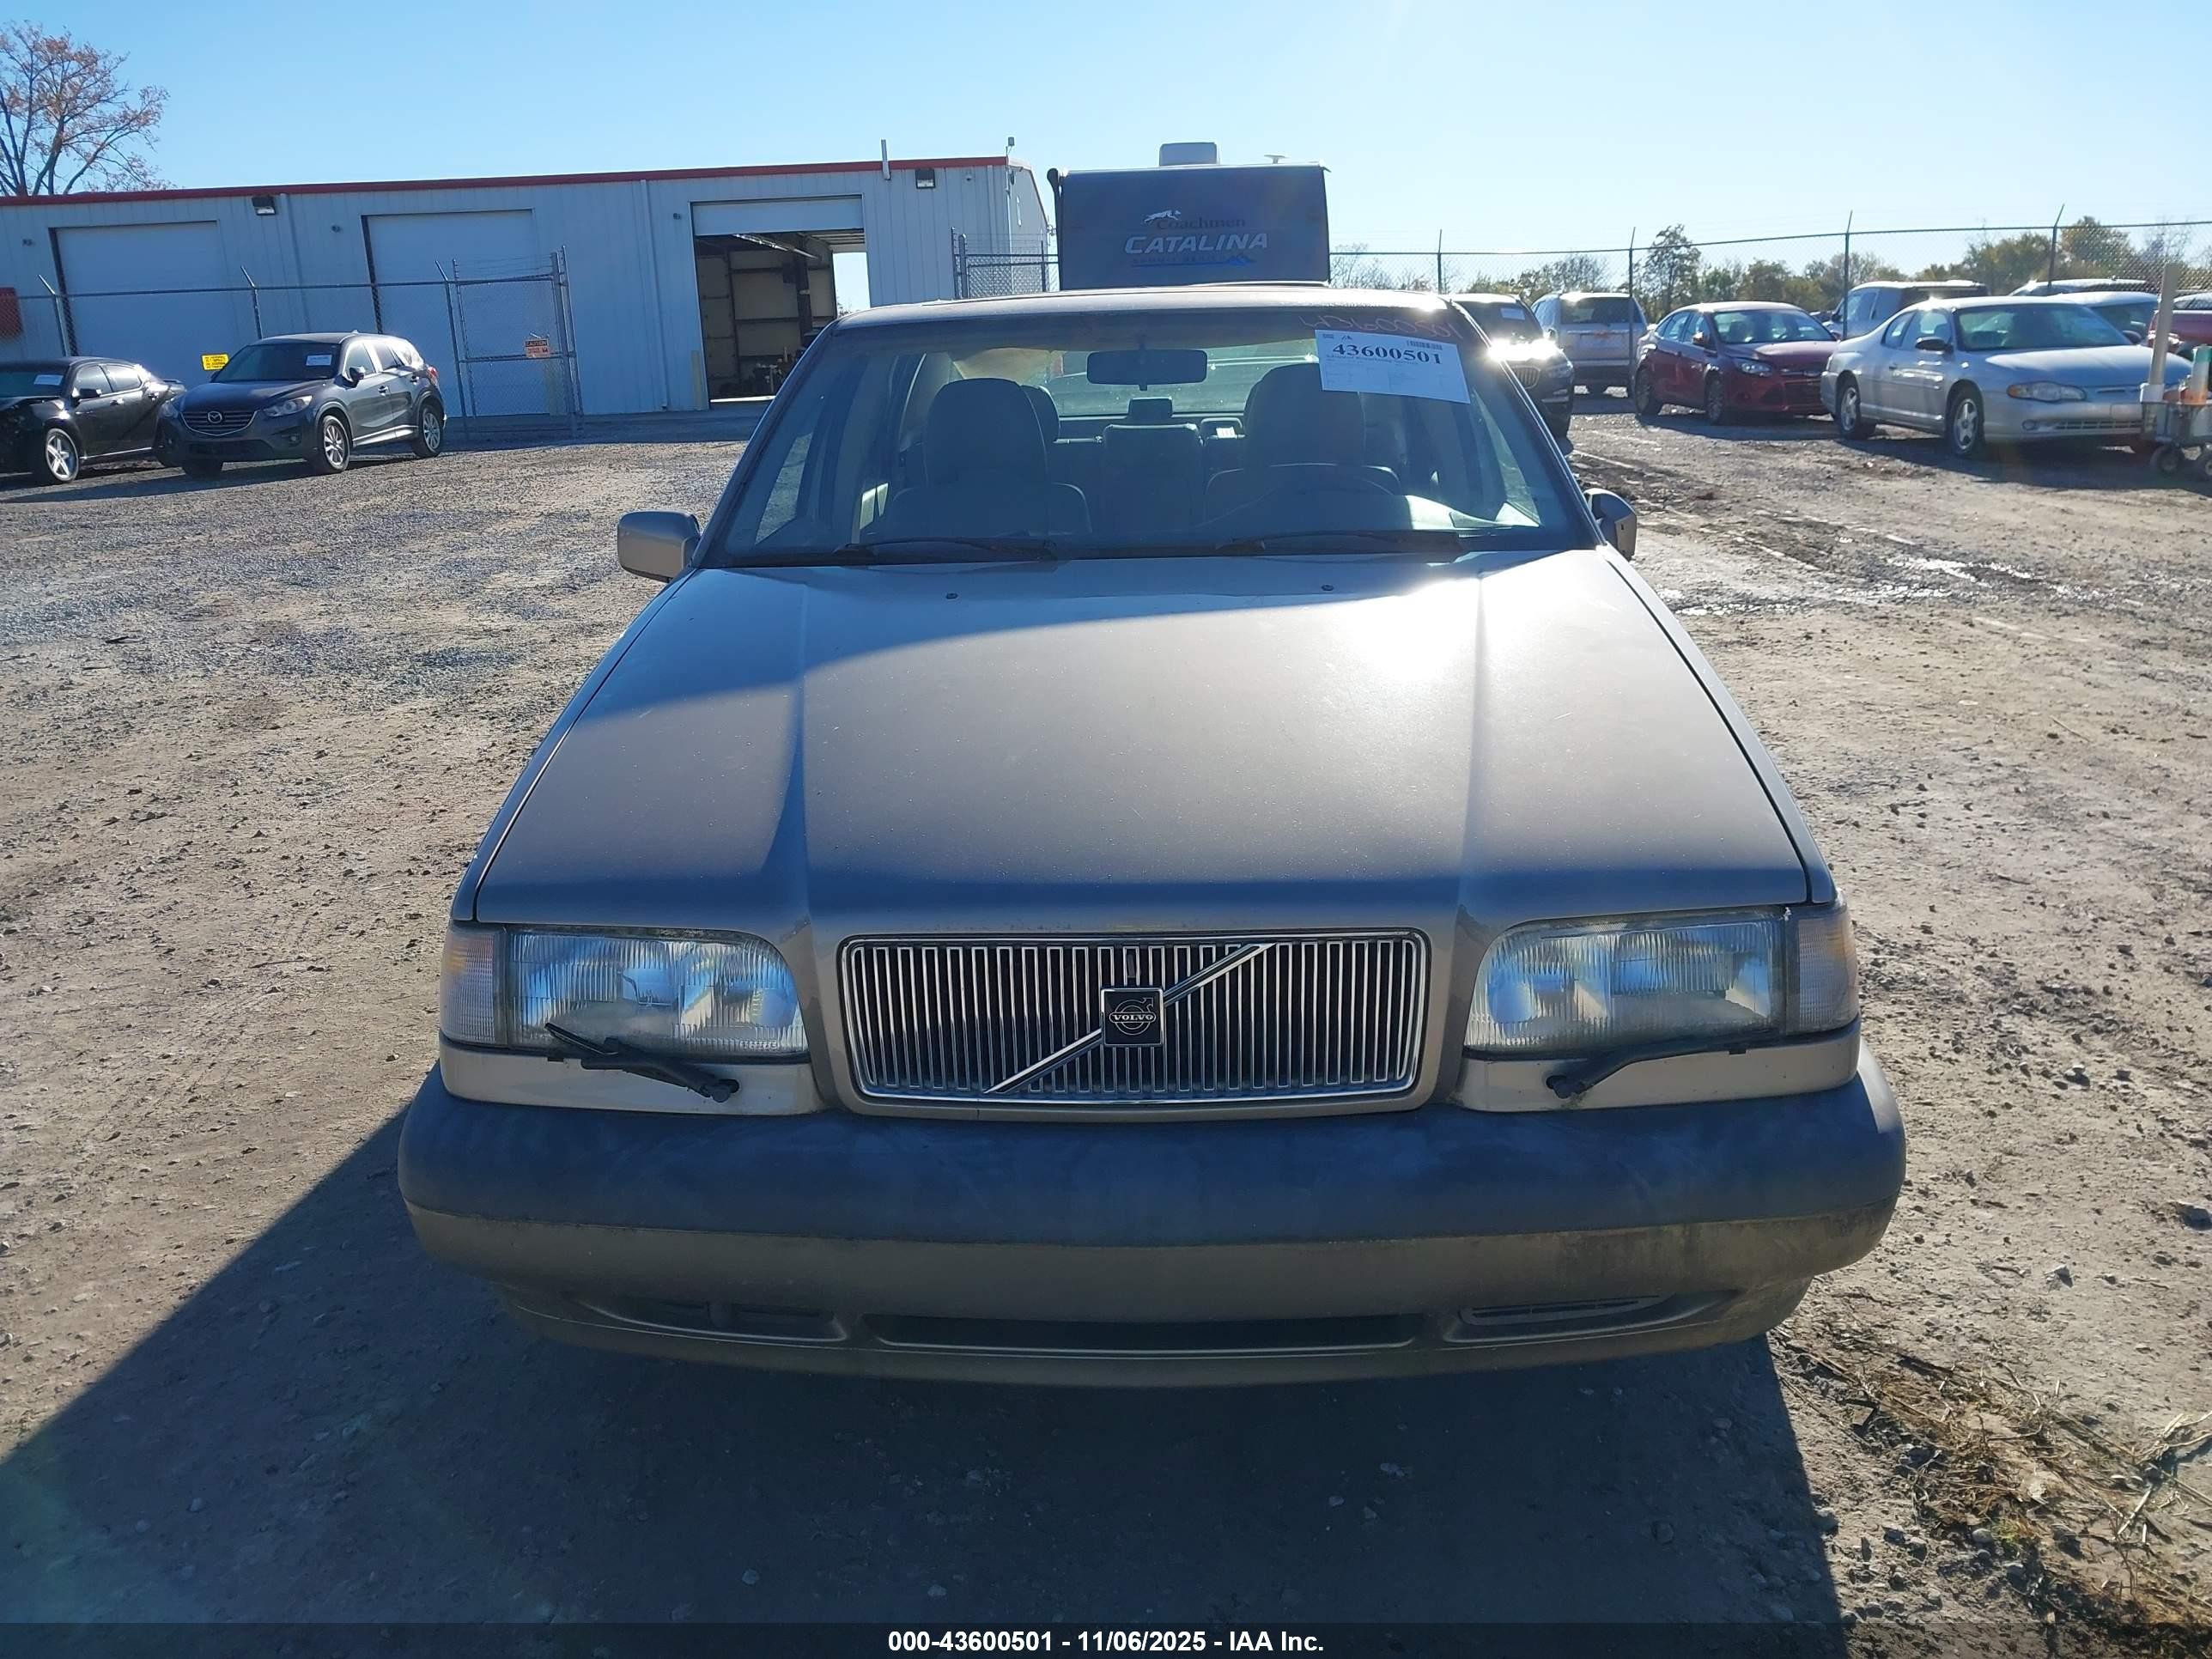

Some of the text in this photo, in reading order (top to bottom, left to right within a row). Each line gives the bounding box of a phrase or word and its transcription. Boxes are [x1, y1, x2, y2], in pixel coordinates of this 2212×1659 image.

[1157, 216, 1246, 230] Coachmen
[1125, 233, 1269, 254] CATALINA
[1332, 343, 1442, 365] 43600501
